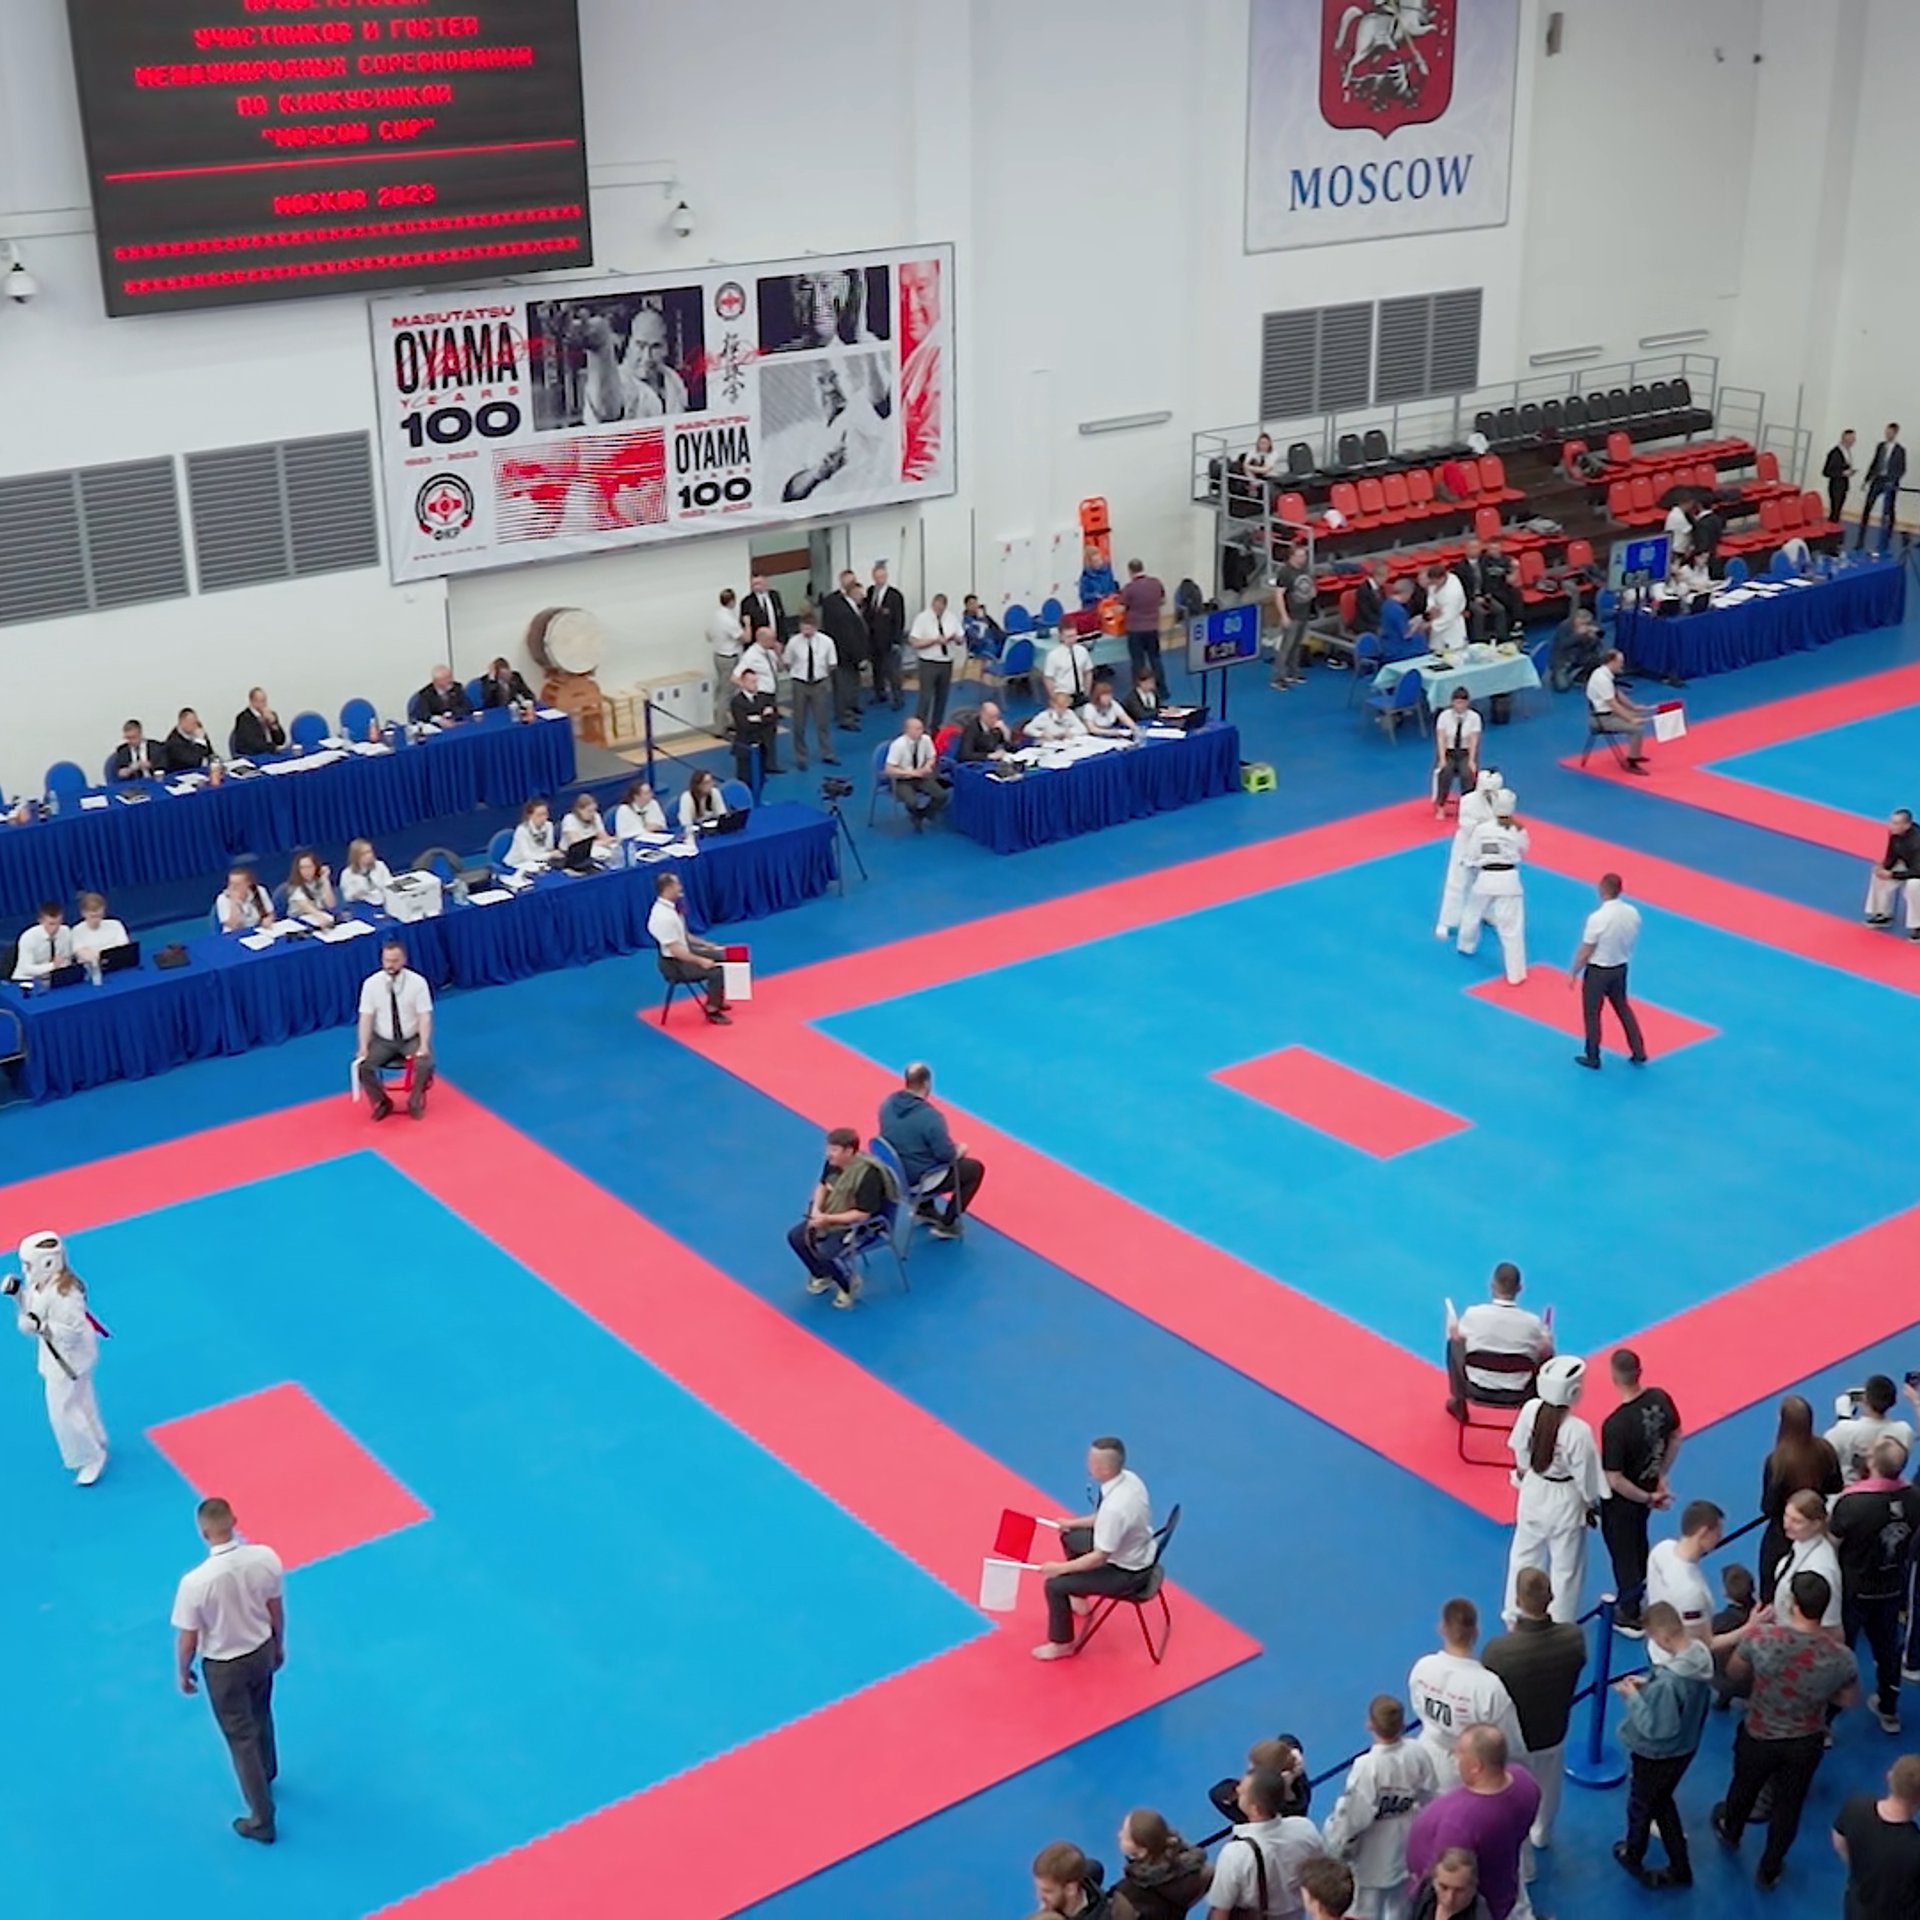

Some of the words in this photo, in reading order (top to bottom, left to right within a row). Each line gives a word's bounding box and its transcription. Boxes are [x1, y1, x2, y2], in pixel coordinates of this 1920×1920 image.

[272, 189, 369, 214] МОСКВА
[376, 183, 436, 207] 2023
[1289, 154, 1473, 212] MOSCOW
[391, 306, 515, 327] MASUTATSU
[394, 321, 519, 394] OYAMA
[400, 401, 521, 447] 100
[675, 425, 751, 474] OYAMA
[678, 477, 752, 509] 100
